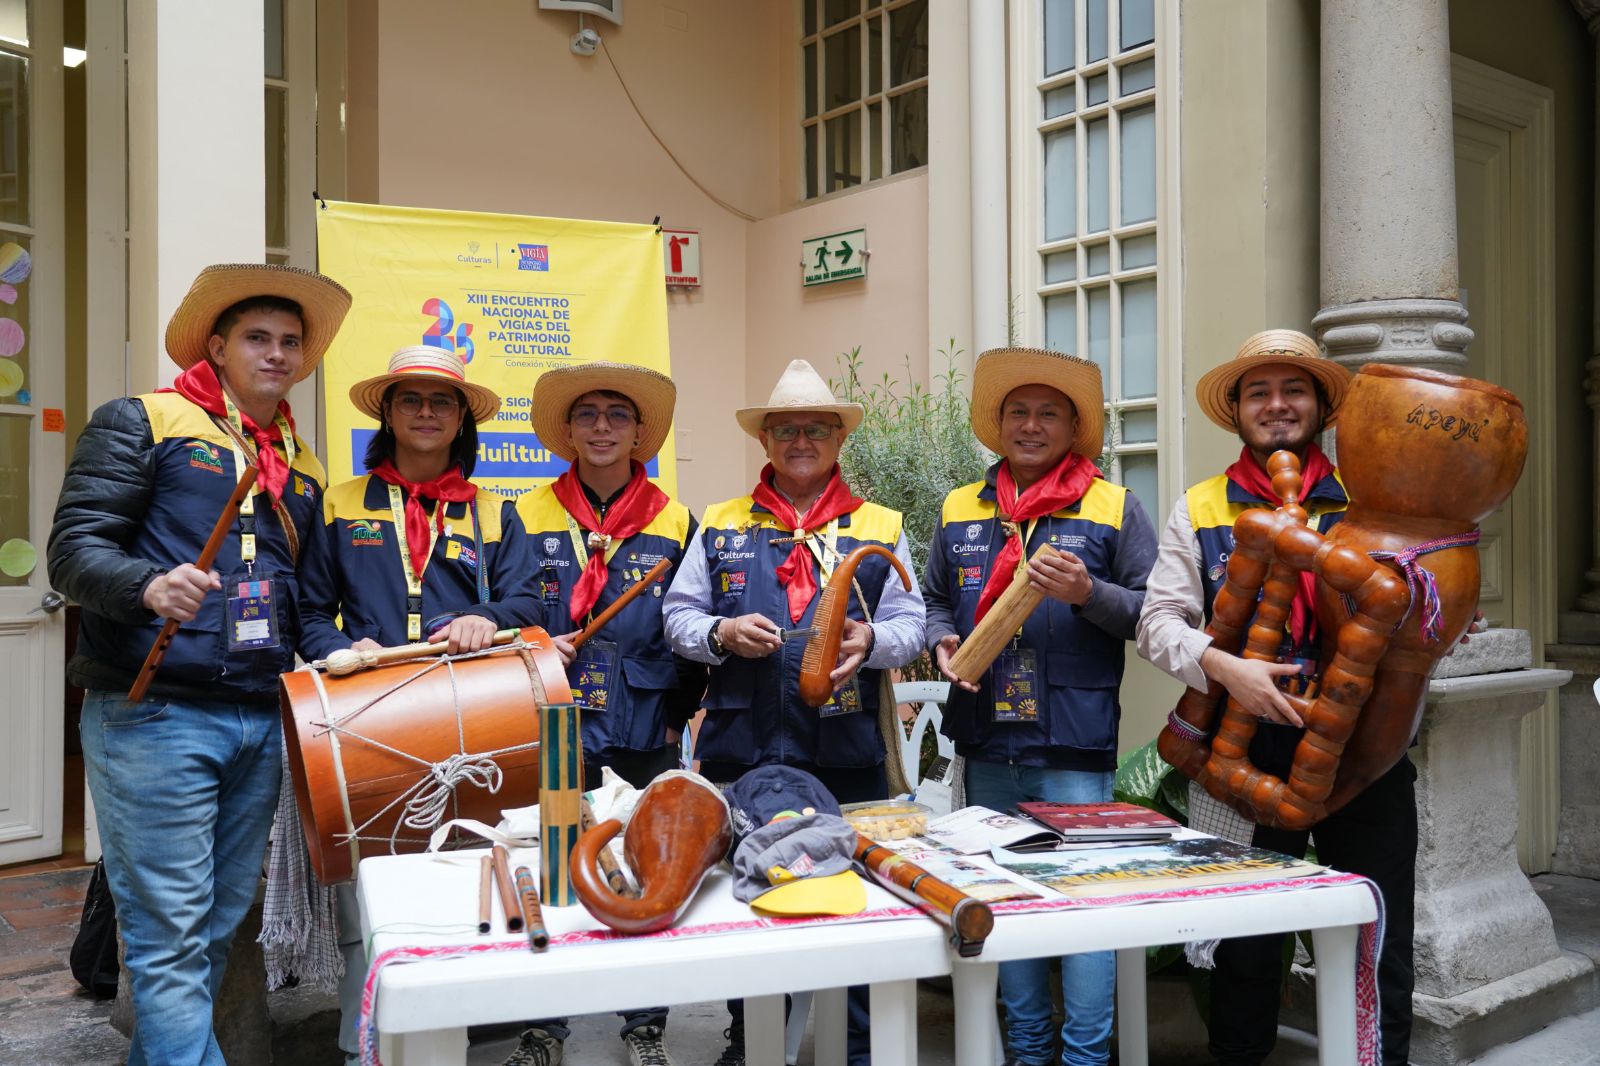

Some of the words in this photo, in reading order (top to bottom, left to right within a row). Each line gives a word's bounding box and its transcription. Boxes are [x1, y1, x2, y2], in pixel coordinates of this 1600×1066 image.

[457, 254, 492, 264] Culturas
[467, 293, 488, 304] XIII
[491, 295, 569, 308] ENCUENTRO
[482, 307, 549, 319] NACIONAL
[553, 310, 570, 320] DE
[499, 317, 543, 331] VIGÍAS
[546, 321, 570, 332] DEL
[488, 331, 571, 344] PATRIMONIO
[504, 344, 572, 356] CULTURAL
[505, 359, 544, 368] Conexión
[953, 543, 990, 554] Culturas
[718, 551, 755, 560] Culturas
[539, 558, 570, 567] ulturas
